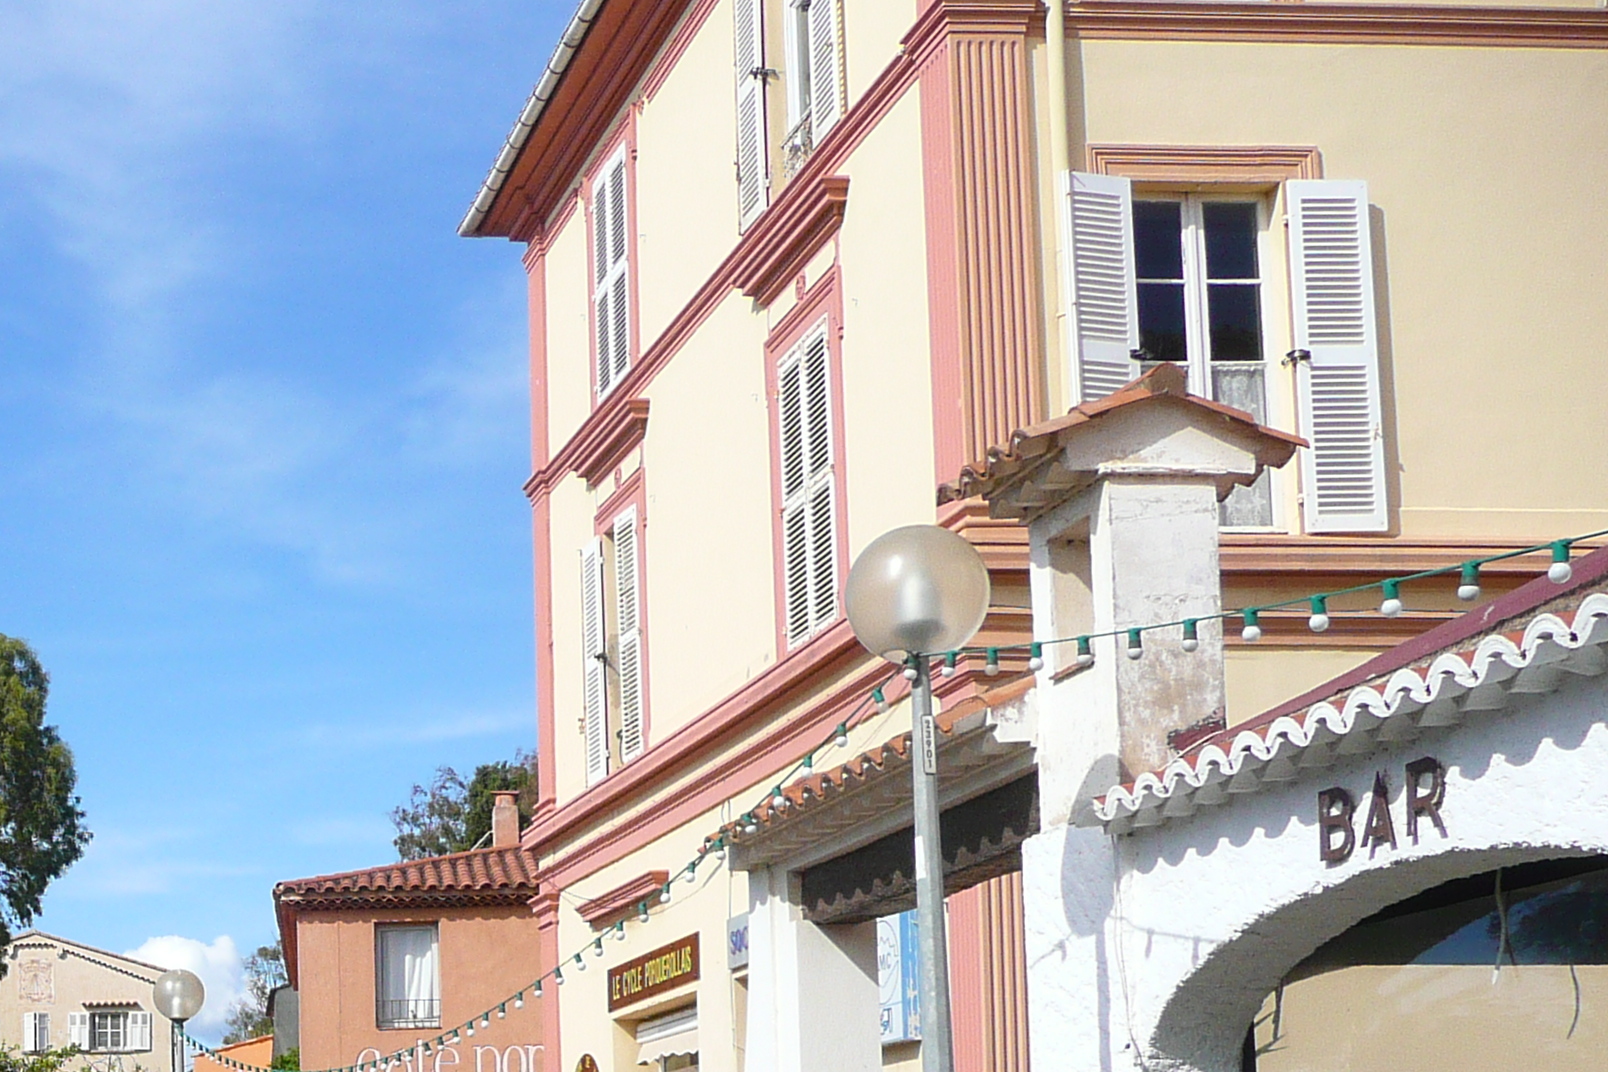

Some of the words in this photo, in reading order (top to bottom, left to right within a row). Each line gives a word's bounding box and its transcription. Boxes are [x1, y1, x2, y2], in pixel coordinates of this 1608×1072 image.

[1318, 756, 1445, 861] BAR
[612, 974, 621, 1001] LE
[622, 965, 643, 997] CYCLE
